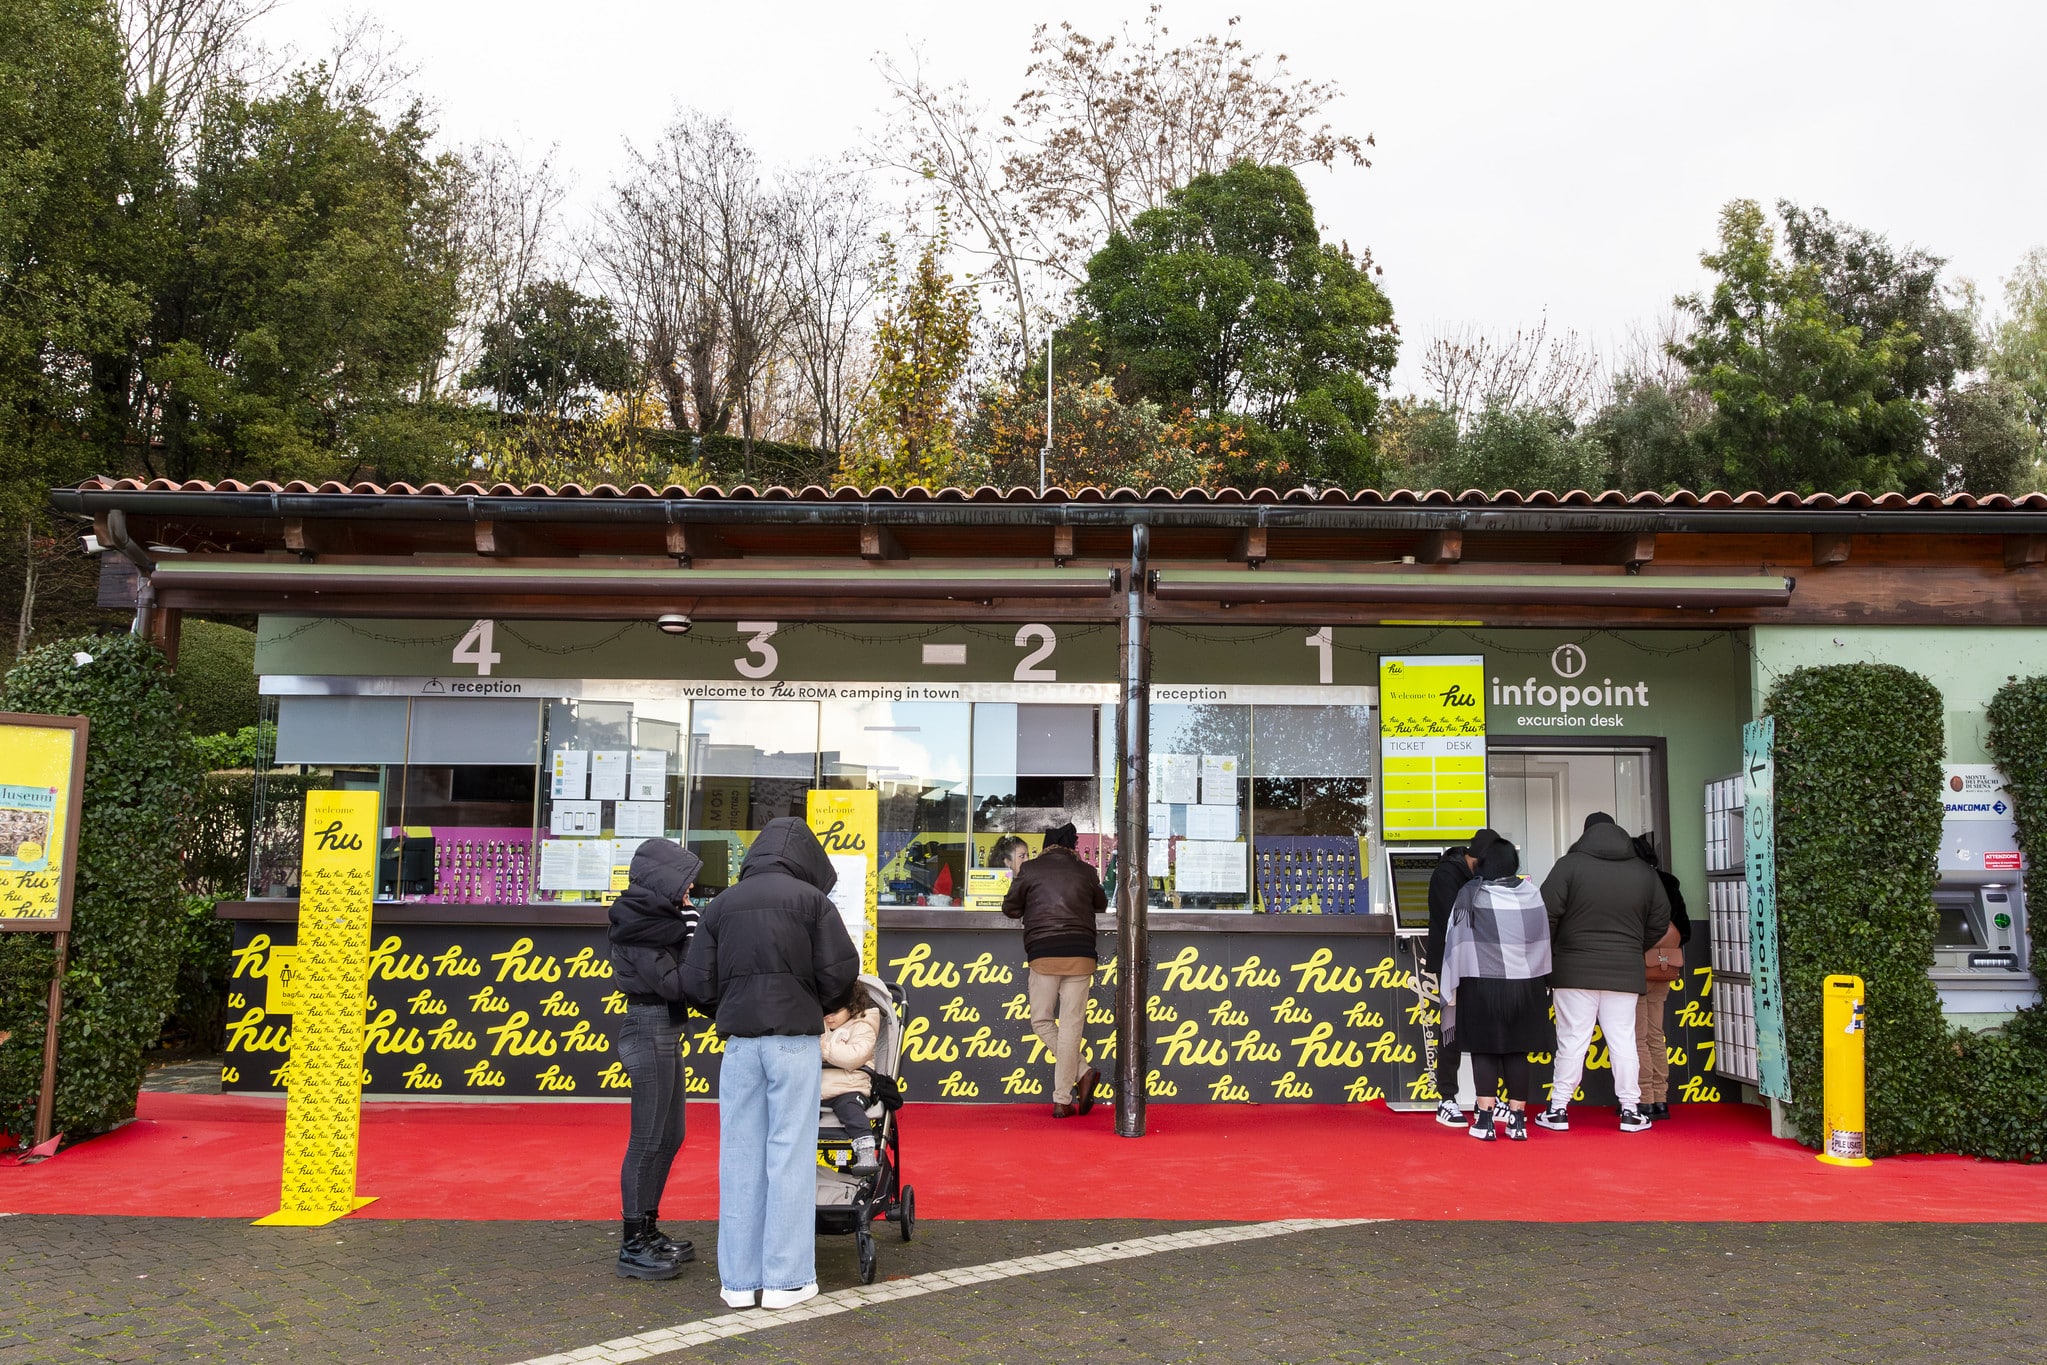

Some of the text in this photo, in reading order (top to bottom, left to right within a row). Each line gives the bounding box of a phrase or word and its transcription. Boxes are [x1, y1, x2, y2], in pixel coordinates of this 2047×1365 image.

[452, 619, 500, 676] 4
[734, 621, 779, 679] 3
[1013, 623, 1057, 681] 2
[1306, 626, 1333, 684] 1
[1387, 663, 1403, 674] hu
[451, 680, 522, 696] reception
[683, 680, 960, 701] welcome to hu ROMA camping in town
[1156, 687, 1227, 702] reception
[1390, 684, 1476, 707] Welcome to hu
[1492, 677, 1649, 712] infopoint
[1517, 713, 1624, 727] excursion desk
[1394, 721, 1412, 733] hu
[1427, 721, 1445, 733] hu
[1460, 721, 1477, 733] hu
[1390, 741, 1472, 751] TICKET DESK
[314, 805, 354, 815] welcome
[816, 806, 855, 815] welcome
[1945, 803, 1991, 812] BANCOMAT
[314, 818, 323, 826] to
[314, 820, 363, 851] hu
[816, 820, 866, 851] hu
[16, 870, 49, 888] hu
[315, 868, 363, 879] hu hu
[314, 885, 362, 896] hu hu
[313, 902, 361, 913] hu hu
[344, 920, 360, 930] hu
[1755, 853, 1771, 1010] infopoint
[311, 936, 359, 948] hu hu
[232, 934, 268, 978] h
[367, 935, 429, 981] hu
[433, 945, 480, 977] hu
[491, 938, 562, 983] hu
[564, 947, 613, 979] hu
[888, 943, 960, 989] hu
[963, 953, 1012, 984] hu
[1157, 946, 1229, 993] hu
[1232, 956, 1280, 988] hu
[1290, 947, 1362, 994] hu
[1365, 956, 1412, 989] hu
[310, 954, 358, 965] hu hu
[309, 971, 357, 982] hu hu
[339, 988, 356, 1000] hu
[468, 986, 510, 1013] hu
[407, 989, 448, 1015] hu
[540, 991, 580, 1017] hu
[306, 1006, 355, 1017] hu hu
[938, 996, 979, 1023] hu
[1209, 999, 1249, 1027] hu
[1271, 996, 1313, 1024] hu
[1343, 1001, 1384, 1028] hu
[1674, 1000, 1714, 1028] hu
[306, 1023, 354, 1034] hu hu
[226, 1006, 291, 1053] hu
[363, 1008, 425, 1054] hu
[428, 1019, 477, 1051] hu
[487, 1011, 558, 1057] hu
[561, 1021, 610, 1053] hu
[901, 1017, 960, 1063] hu
[961, 1026, 1012, 1059] hu
[1155, 1019, 1229, 1067] hu
[1231, 1029, 1281, 1062] hu
[1290, 1021, 1363, 1068] hu
[1366, 1031, 1417, 1064] hu
[304, 1040, 353, 1052] hu hu
[304, 1058, 352, 1070] hu hu
[302, 1076, 351, 1087] hu hu
[403, 1063, 443, 1089] hu
[464, 1060, 506, 1087] hu
[536, 1065, 576, 1092] hu
[937, 1071, 979, 1098] hu
[1000, 1067, 1043, 1095] hu
[1208, 1074, 1249, 1102] hu
[1271, 1071, 1313, 1099] hu
[1343, 1075, 1387, 1103] hu
[1678, 1075, 1721, 1103] hu
[301, 1093, 350, 1104] hu hu
[301, 1111, 349, 1122] hu hu
[299, 1128, 348, 1140] hu hu
[1835, 1139, 1846, 1148] PILE
[298, 1146, 347, 1158] hu hu
[298, 1164, 346, 1176] hu hu
[296, 1182, 345, 1194] hu hu
[296, 1200, 344, 1212] hu hu
